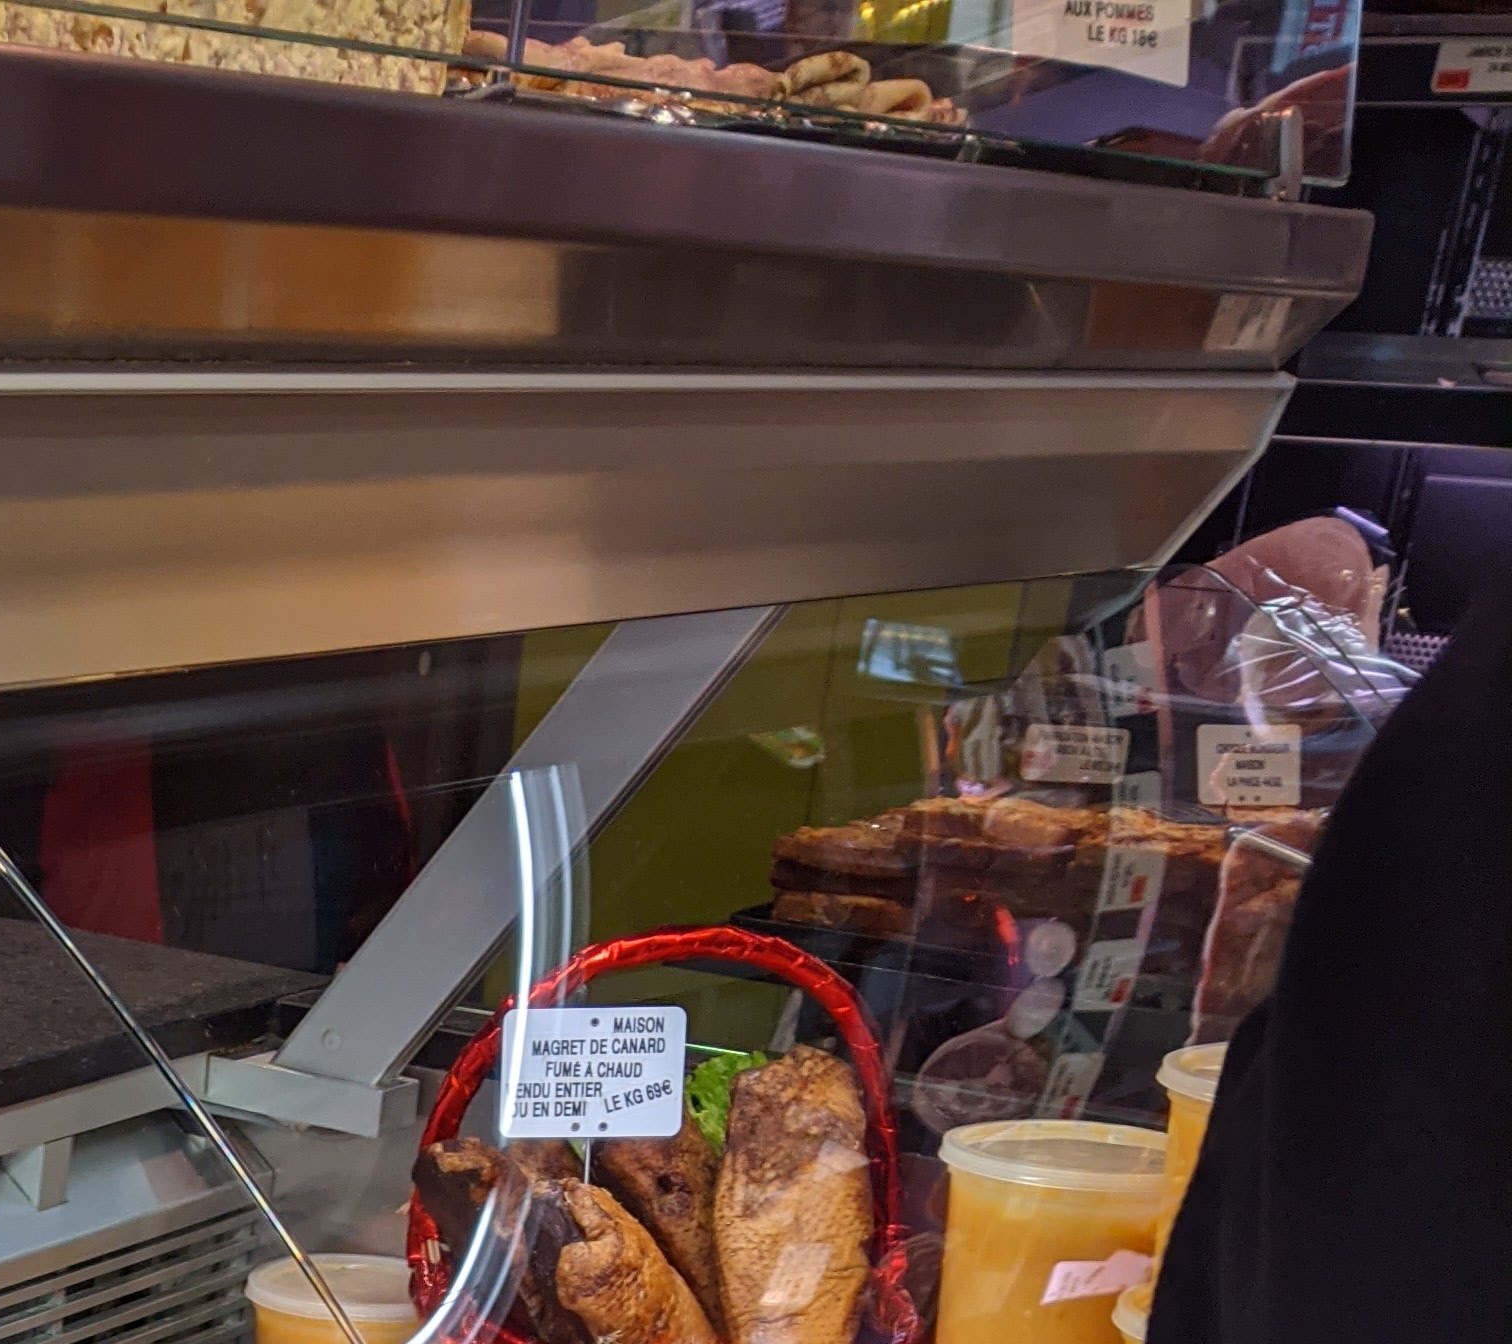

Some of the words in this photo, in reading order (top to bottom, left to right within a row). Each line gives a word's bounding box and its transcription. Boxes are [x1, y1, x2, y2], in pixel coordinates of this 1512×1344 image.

[1064, 0, 1091, 17] AUX
[1095, 2, 1154, 21] POMMES
[1088, 25, 1104, 42] LE
[1108, 27, 1127, 43] KG
[613, 1017, 665, 1033] MAISON
[532, 1039, 586, 1056] MAGRET
[590, 1039, 608, 1055] DE
[611, 1038, 665, 1054] CANARD
[545, 1061, 581, 1078] FUMÉ
[597, 1062, 643, 1078] CHAUD
[506, 1082, 550, 1099] ENDU
[555, 1082, 603, 1098] ENTIER
[603, 1095, 622, 1114] LE
[624, 1089, 643, 1107] KG
[646, 1079, 673, 1100] 69€
[532, 1101, 549, 1117] EN
[554, 1101, 586, 1117] DEMI
